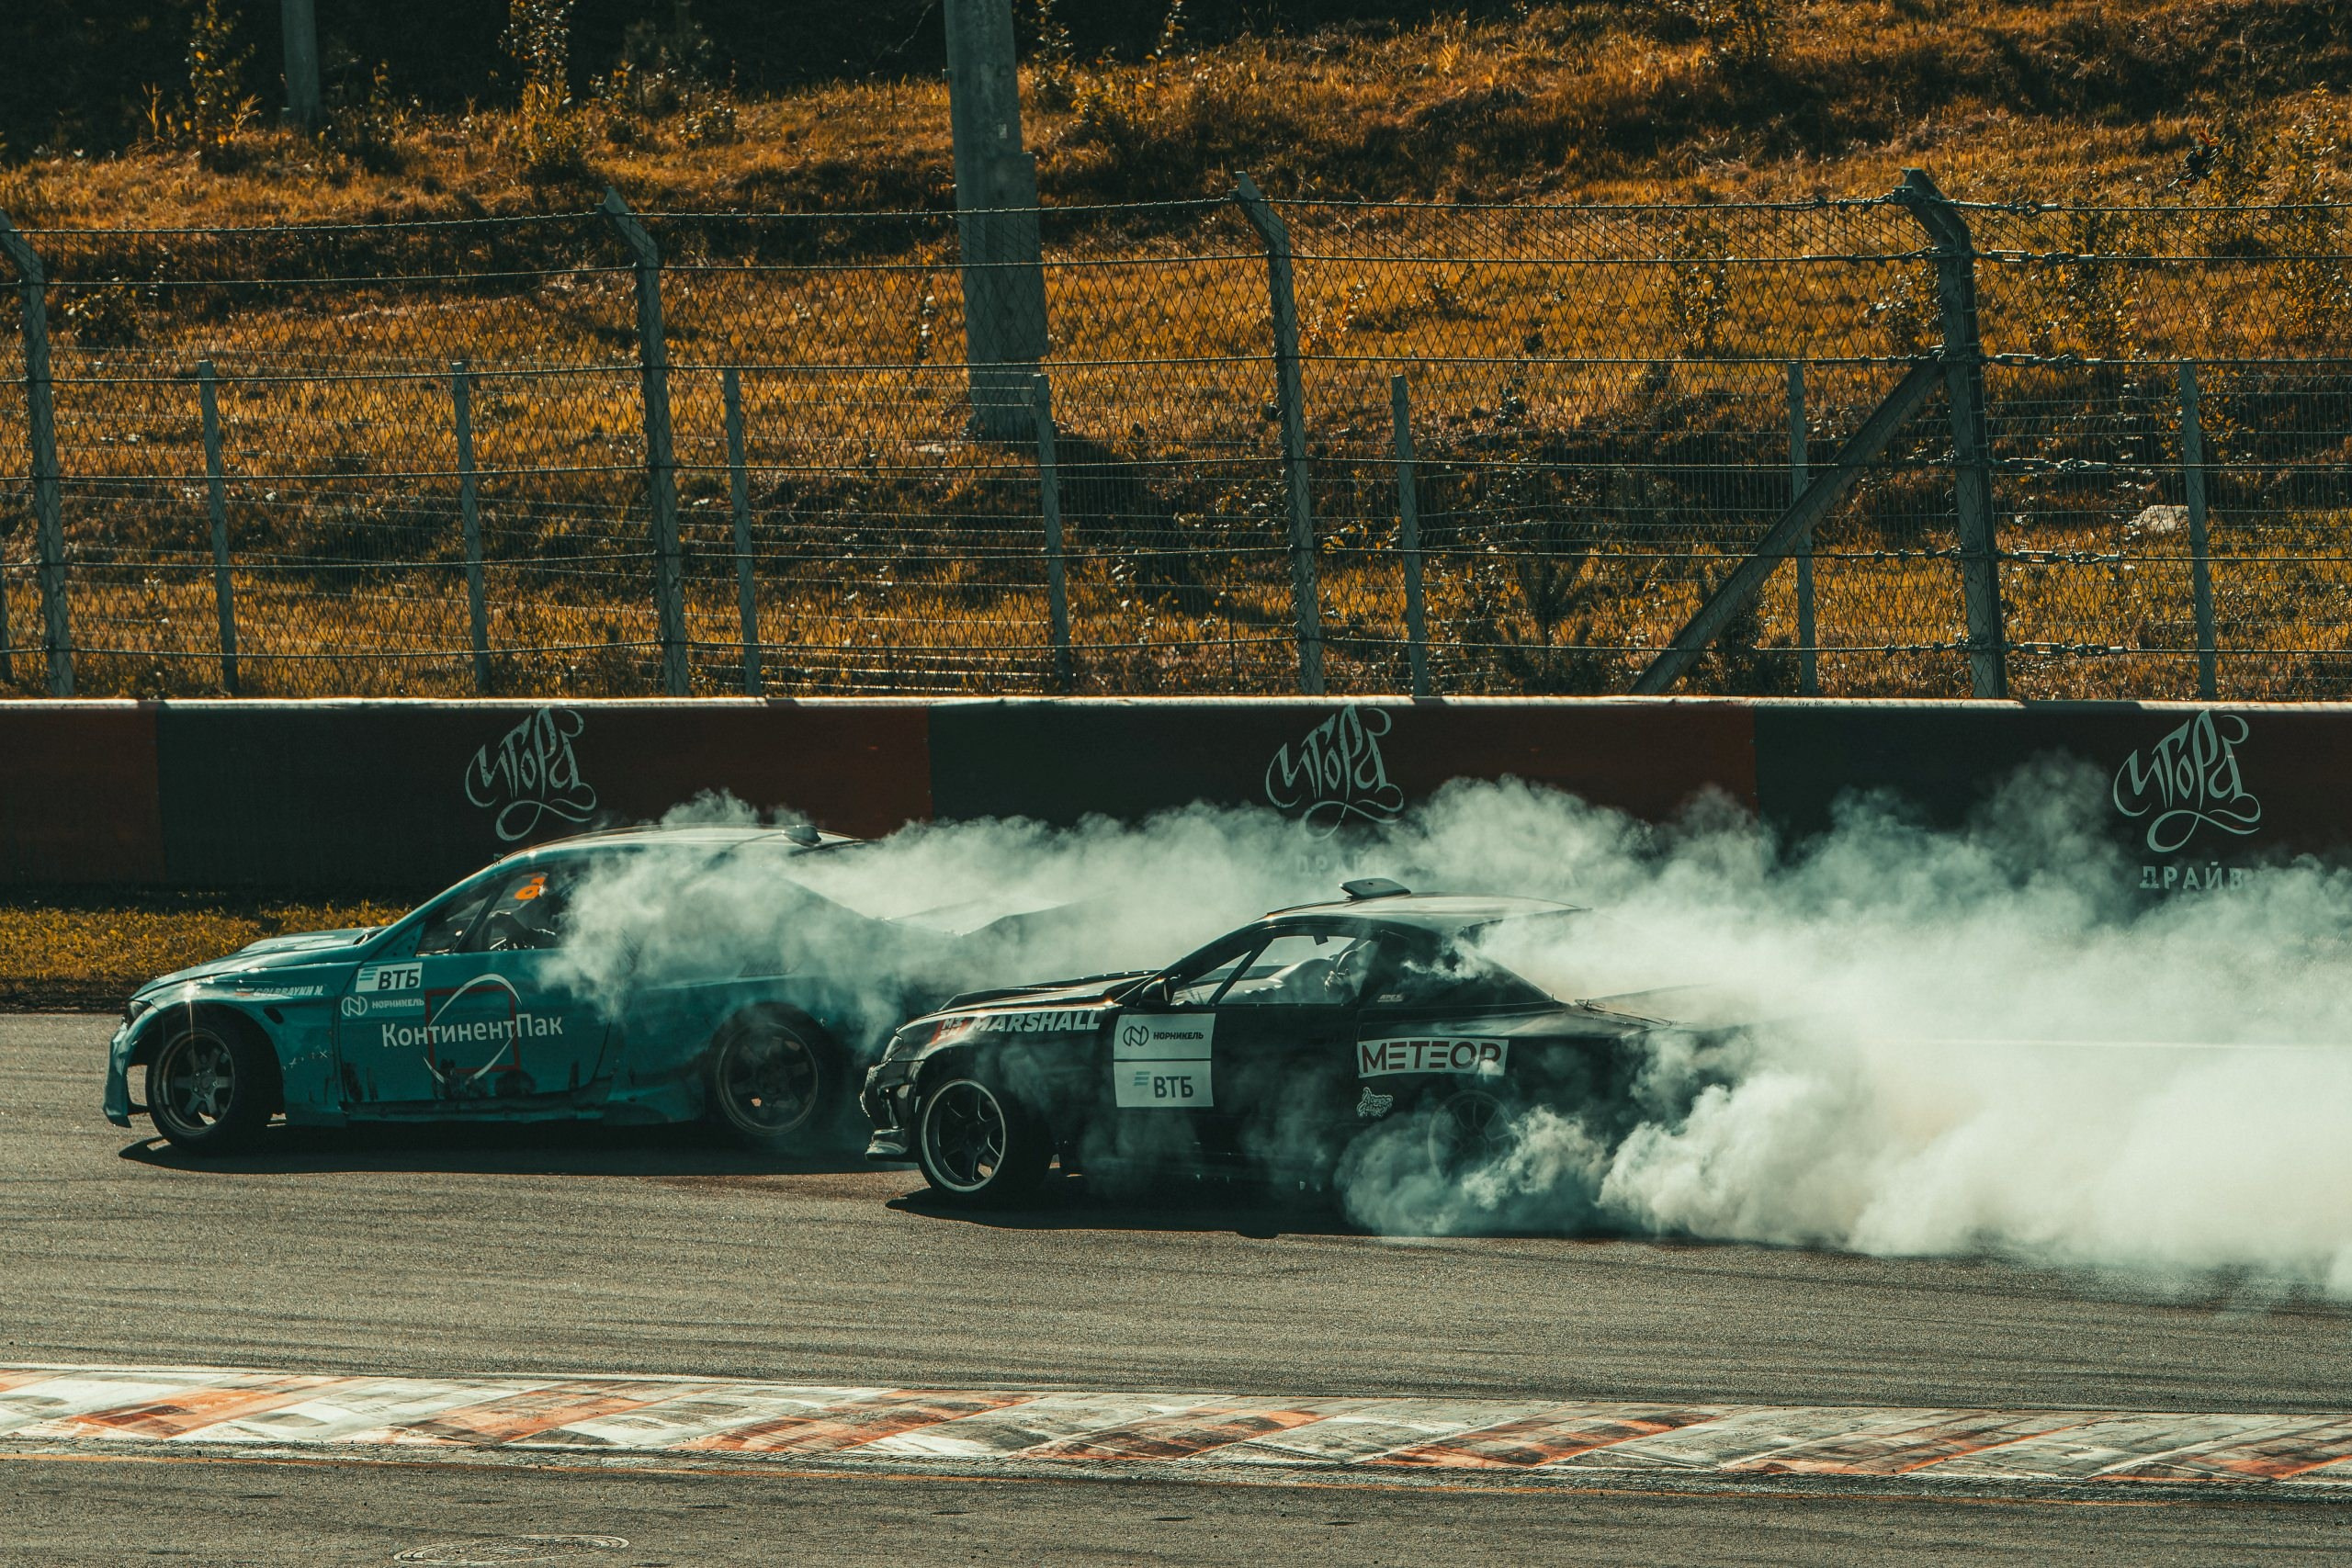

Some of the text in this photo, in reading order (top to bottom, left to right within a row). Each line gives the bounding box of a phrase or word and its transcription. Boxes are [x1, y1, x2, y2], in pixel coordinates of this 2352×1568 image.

[2139, 862, 2244, 890] ДРАЙВ
[378, 968, 420, 990] ВТБ
[371, 998, 424, 1010] НОРНИКЕЛЬ
[381, 1013, 563, 1047] КонтинентПак
[970, 1011, 1101, 1032] MARSHALL
[1153, 1032, 1204, 1040] НОРНИКЕЛЬ
[1362, 1041, 1502, 1073] METEOR
[1153, 1076, 1193, 1099] ВТБ
